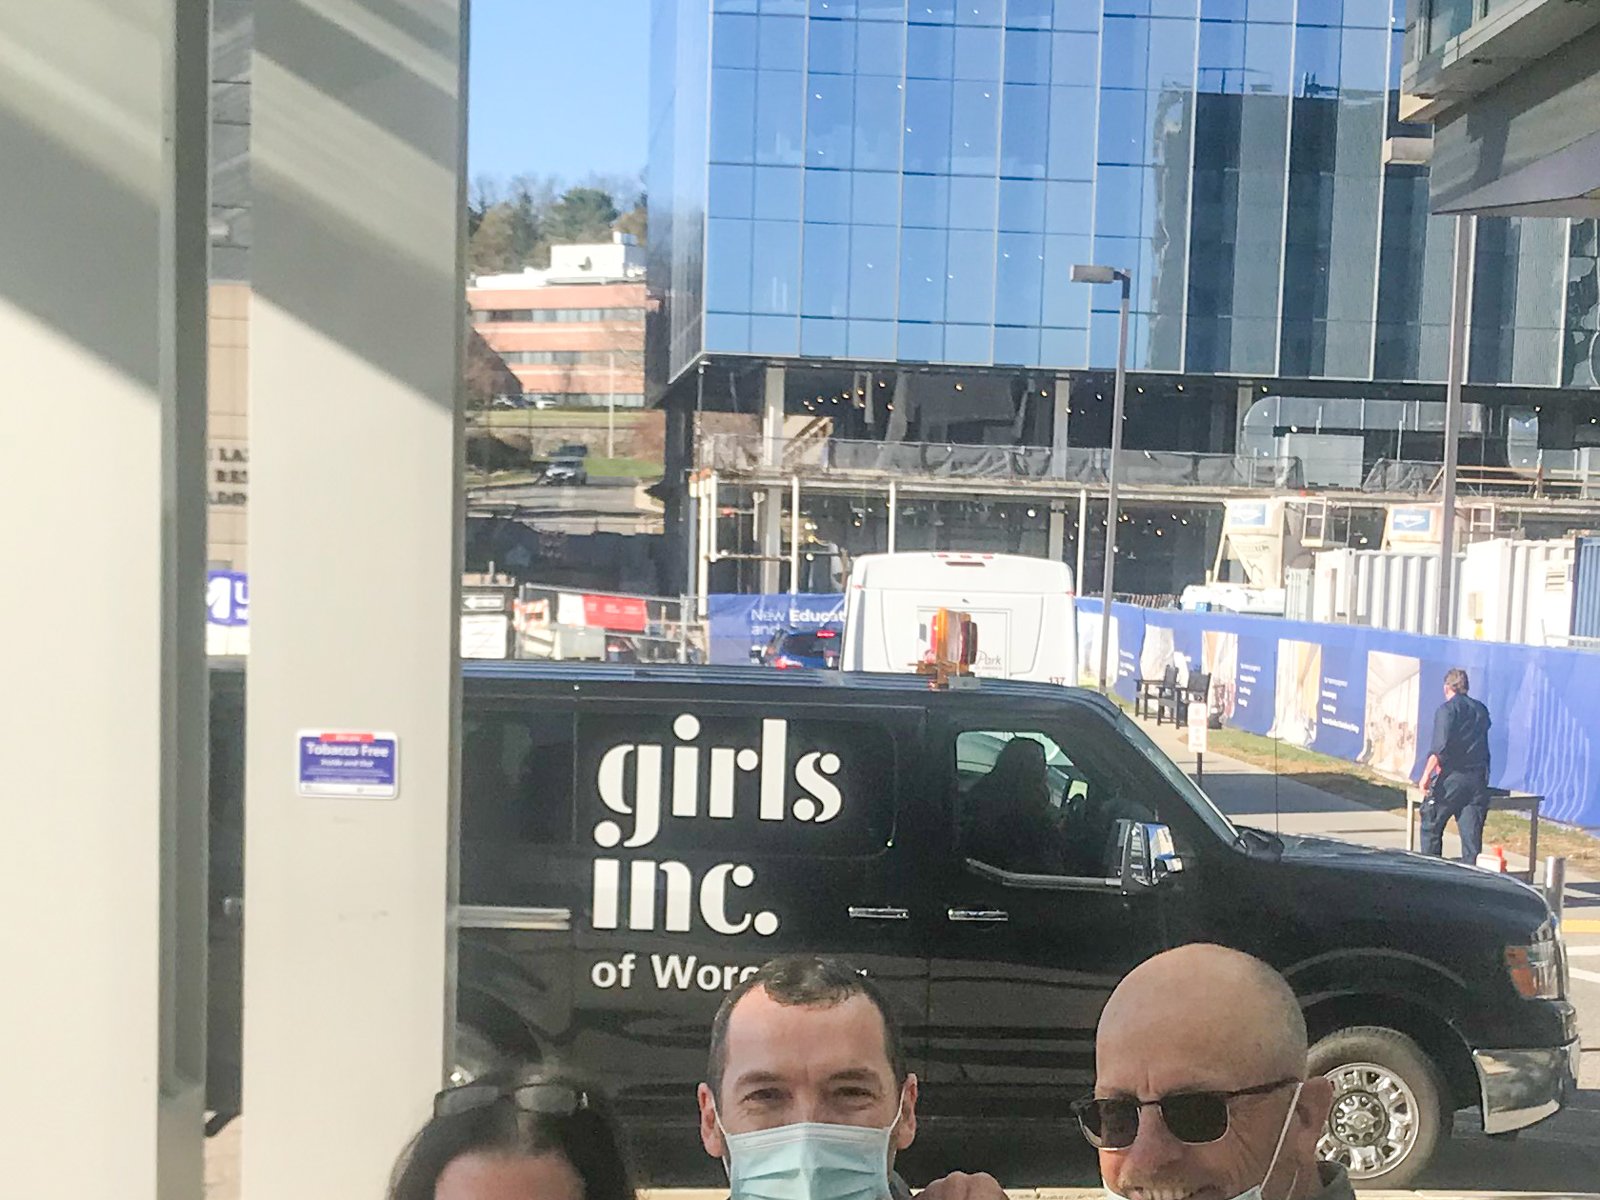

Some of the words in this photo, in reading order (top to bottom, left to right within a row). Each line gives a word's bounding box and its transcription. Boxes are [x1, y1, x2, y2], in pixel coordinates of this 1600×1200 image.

[751, 609, 784, 621] New
[306, 741, 359, 756] Tobacco
[361, 744, 389, 758] Free
[594, 714, 842, 848] girls
[593, 858, 779, 936] inc.
[592, 953, 637, 988] of
